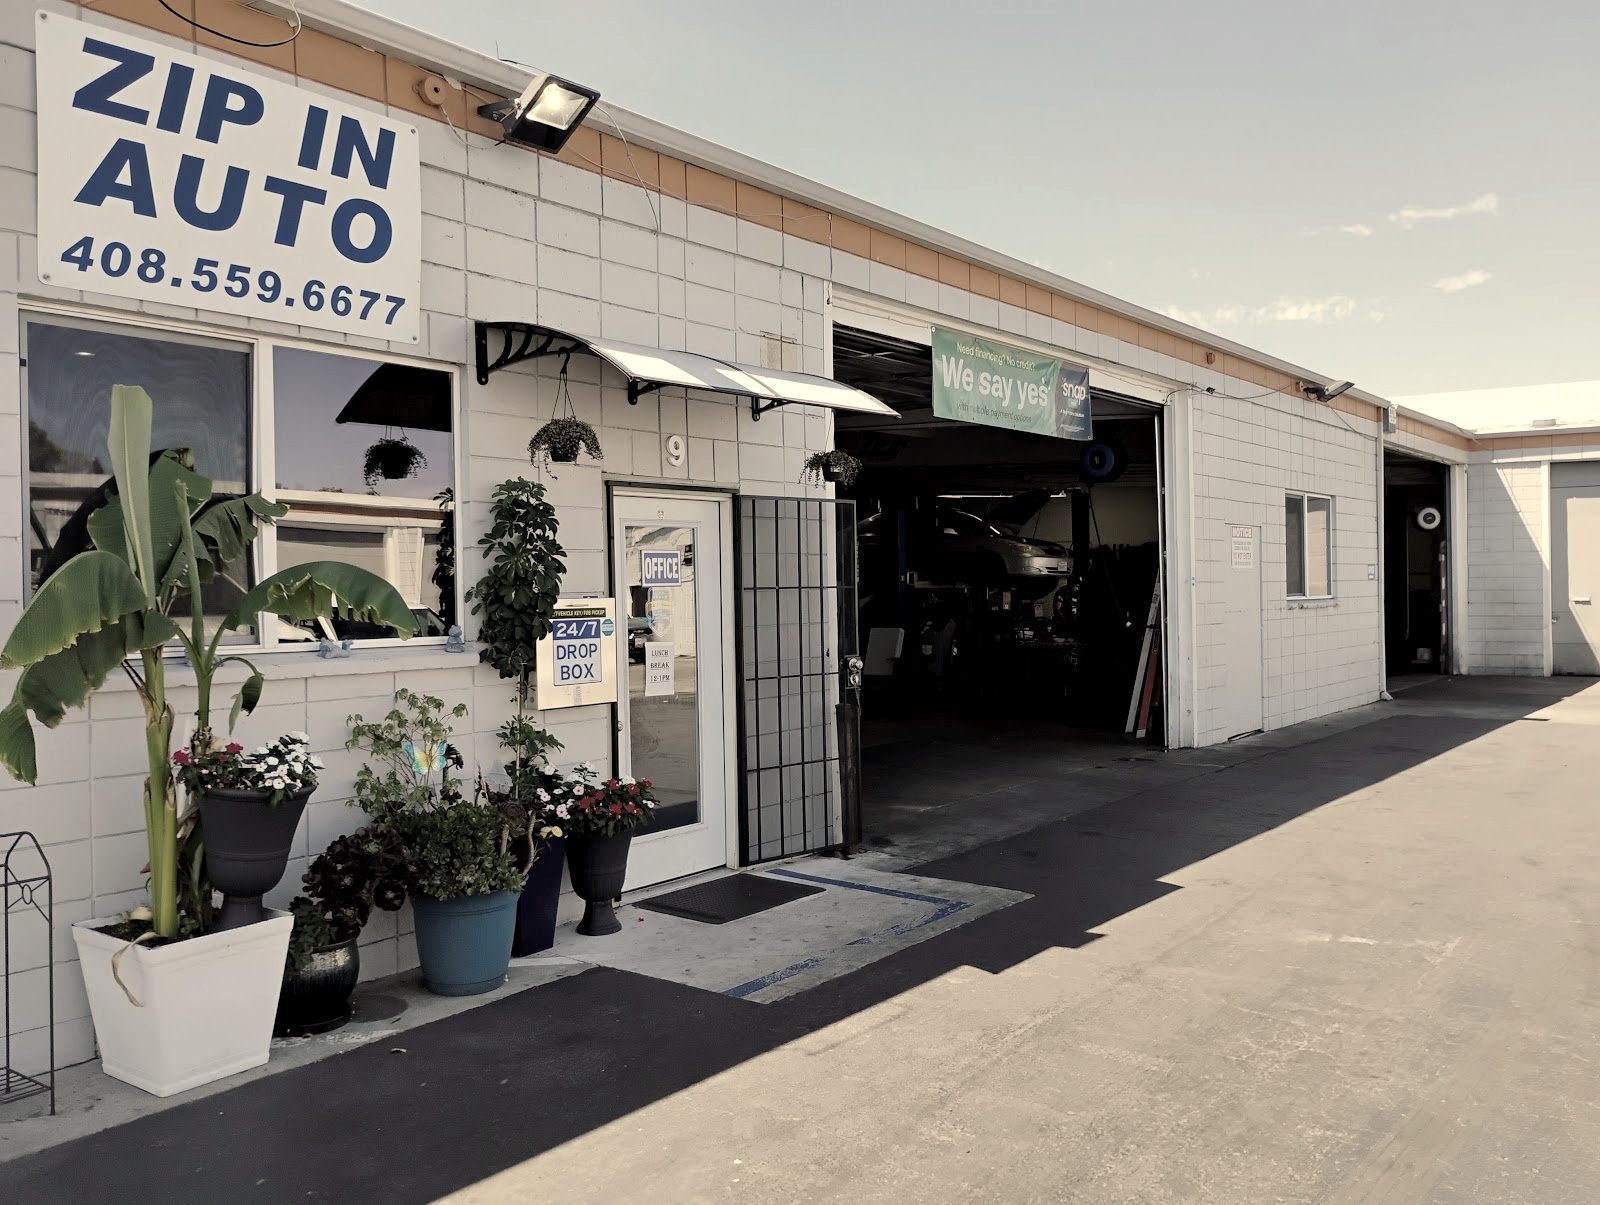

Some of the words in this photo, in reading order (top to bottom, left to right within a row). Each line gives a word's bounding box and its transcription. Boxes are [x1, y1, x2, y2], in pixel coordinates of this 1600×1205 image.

[72, 37, 265, 144] ZIP
[297, 104, 396, 190] IN
[73, 137, 393, 264] AUTO
[60, 236, 406, 325] 408.559.6677
[956, 342, 974, 356] Need
[975, 346, 1006, 366] financing?
[1006, 355, 1015, 366] No
[941, 354, 974, 392] We
[978, 371, 1013, 408] say
[1017, 379, 1049, 410] yes
[667, 434, 685, 467] 9
[1232, 527, 1252, 538] NOTICE
[645, 557, 679, 580] OFFICE
[556, 621, 598, 638] 24/7
[556, 643, 598, 660] DROP
[651, 649, 669, 657] LUNCH
[560, 663, 595, 681] BOX
